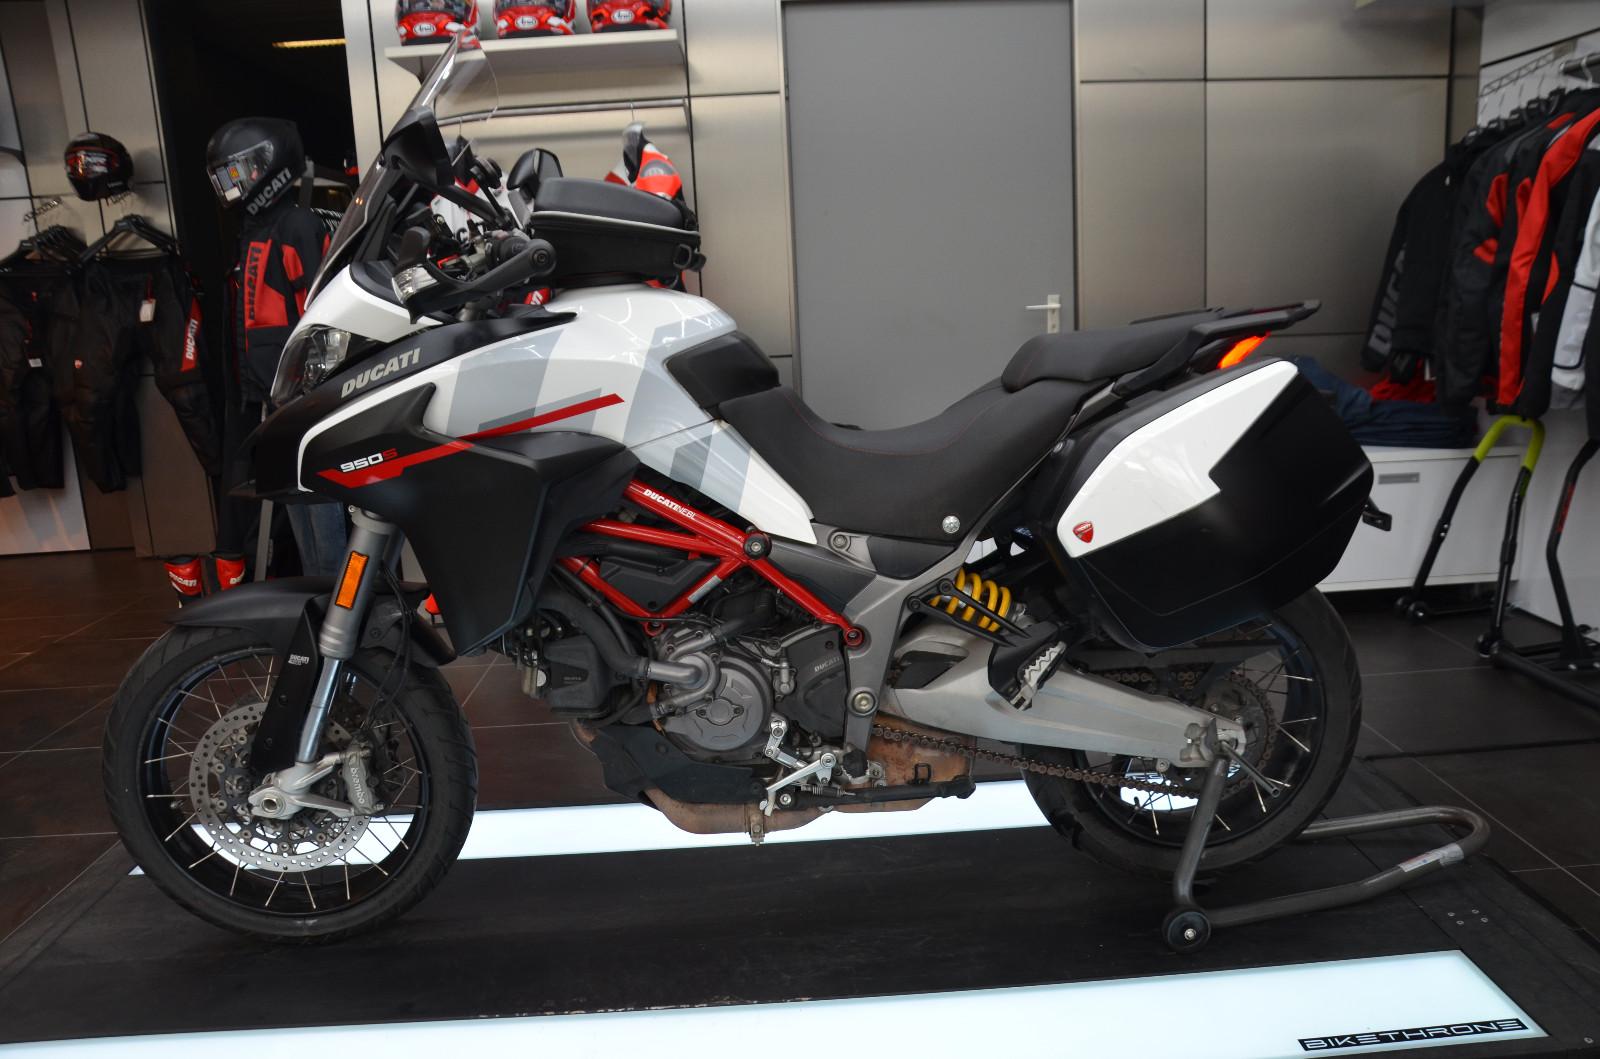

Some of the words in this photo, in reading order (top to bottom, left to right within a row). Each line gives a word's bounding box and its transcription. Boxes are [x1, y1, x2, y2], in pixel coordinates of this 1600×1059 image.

[246, 167, 292, 215] DUCATI
[185, 318, 198, 360] DUCATI
[341, 347, 421, 398] DUCATI
[340, 447, 399, 473] 950S
[814, 656, 840, 672] DUCATI
[350, 767, 366, 804] brembo
[1303, 1020, 1523, 1049] BIKETHRONE
